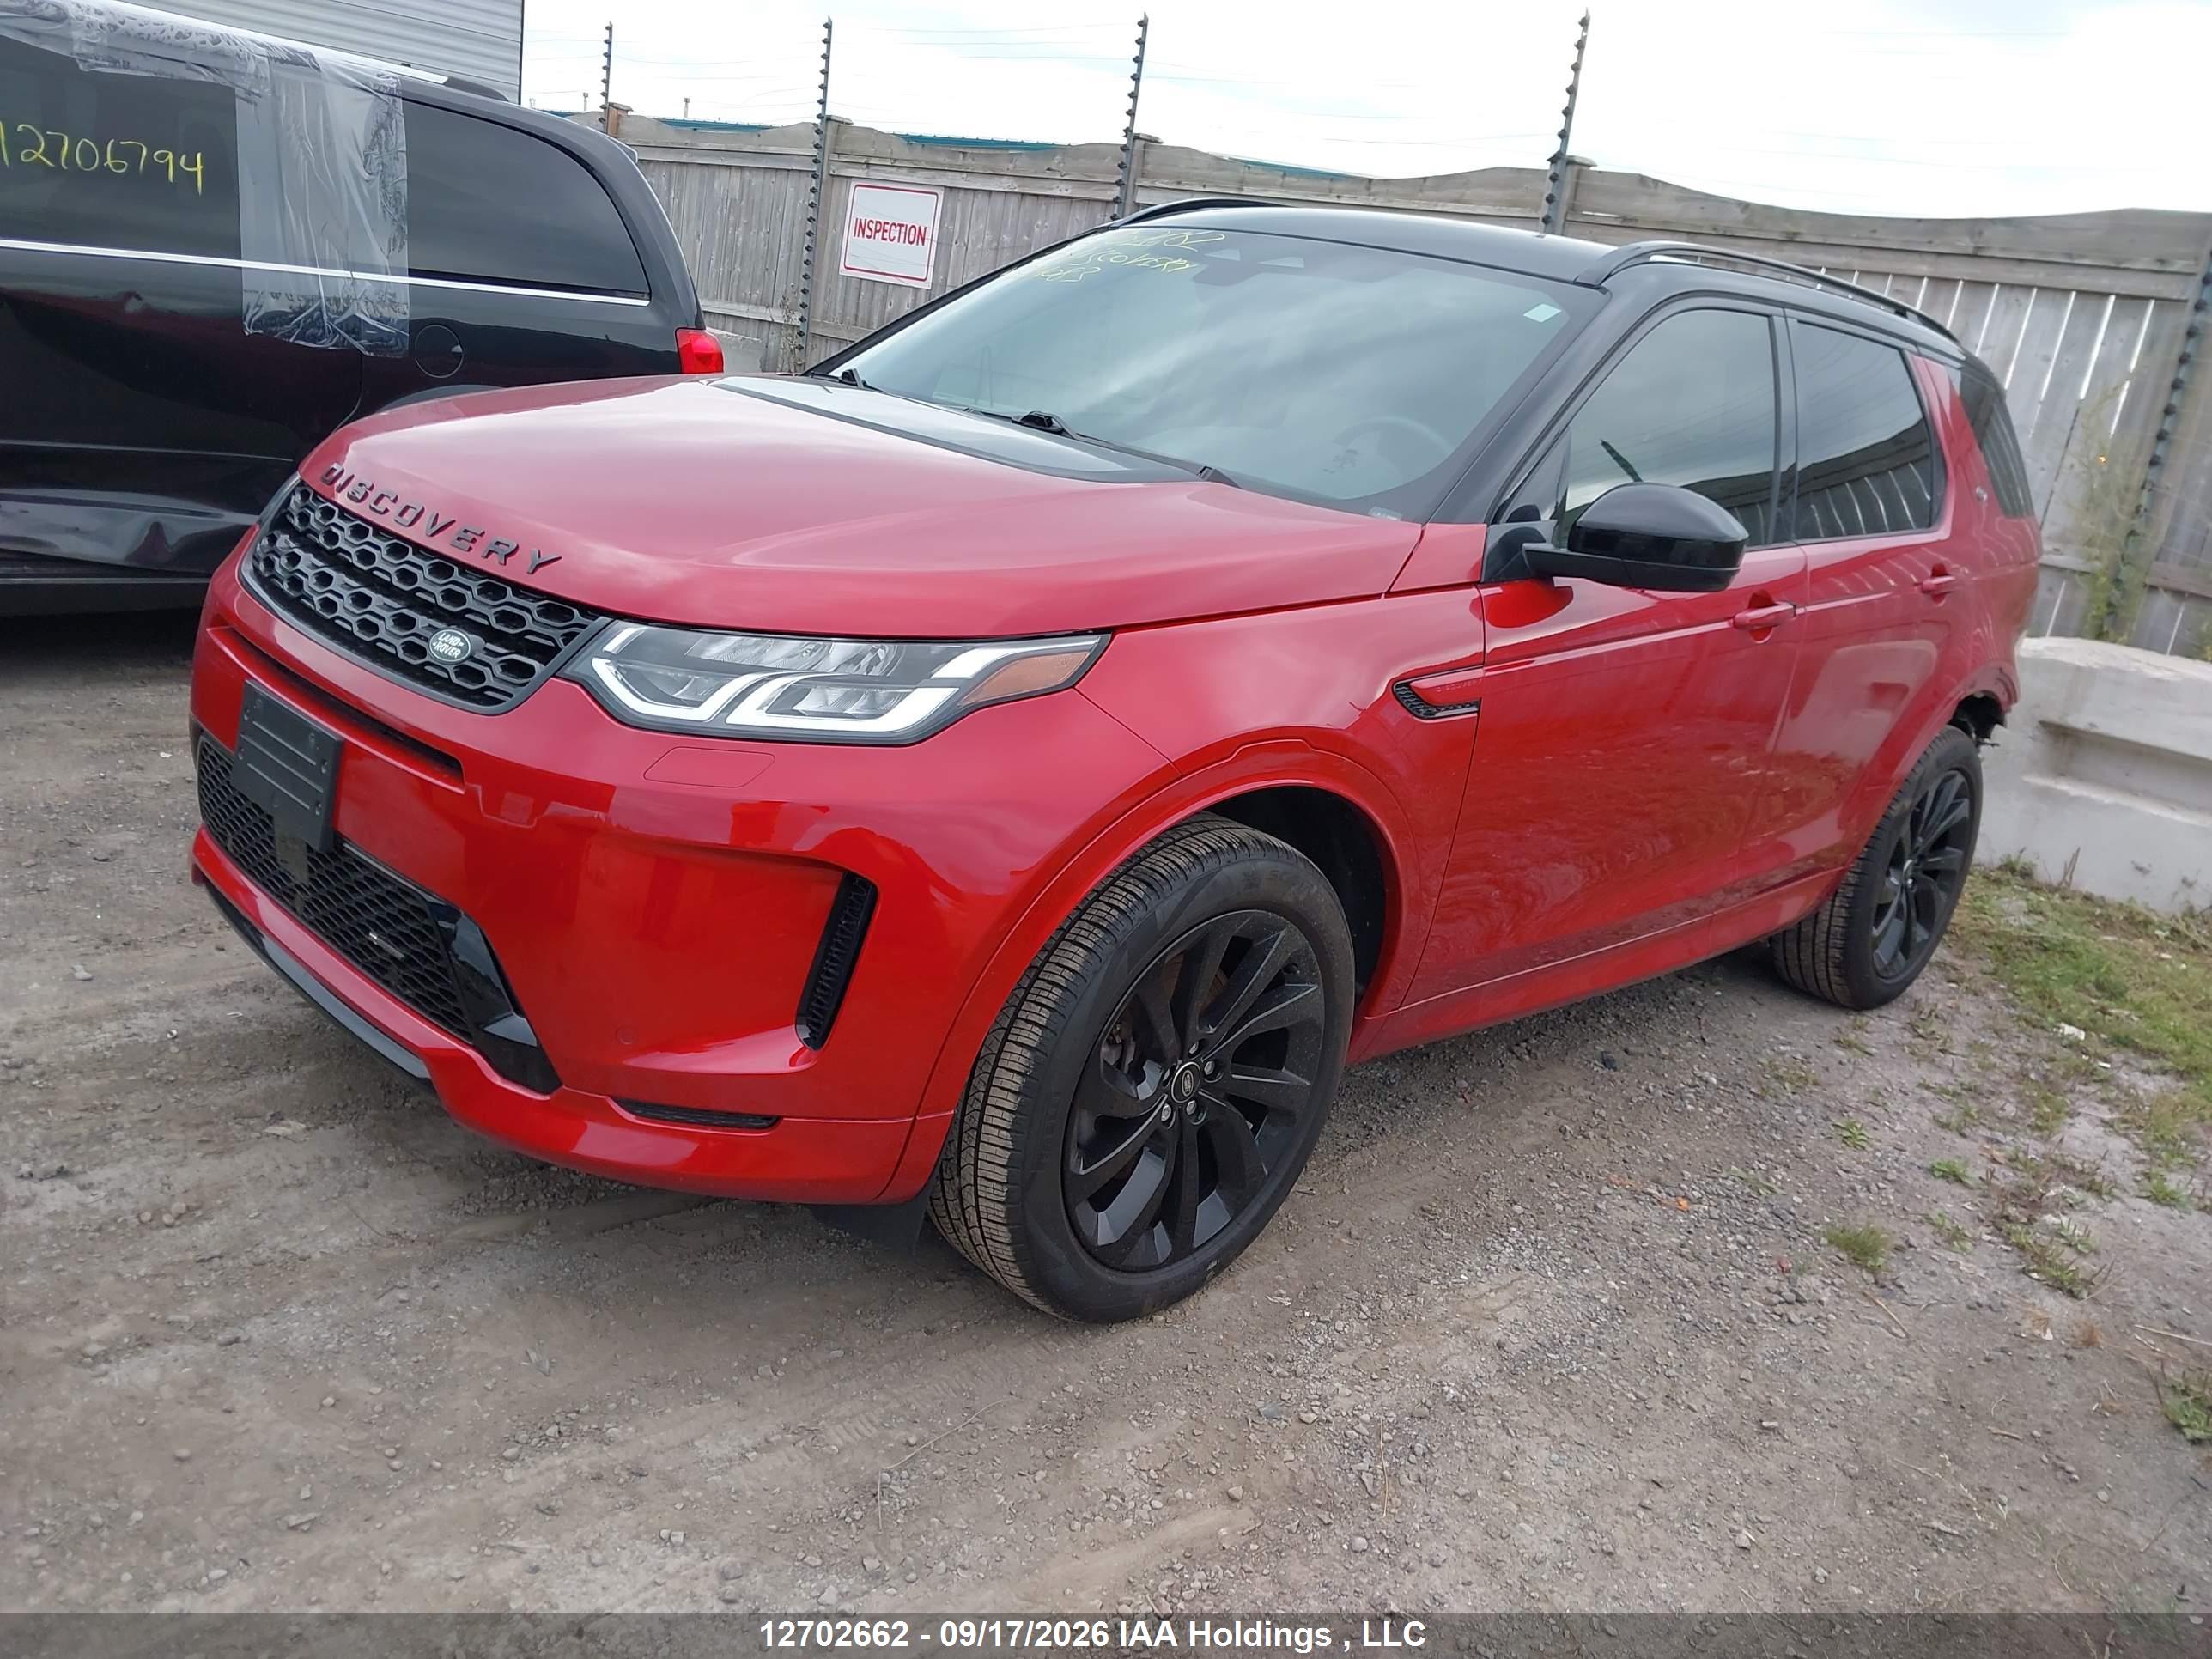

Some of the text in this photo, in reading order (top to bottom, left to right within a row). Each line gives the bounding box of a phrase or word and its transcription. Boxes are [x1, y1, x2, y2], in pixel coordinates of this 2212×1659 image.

[0, 120, 204, 197] 12706794
[853, 217, 927, 246] INSPECTION
[320, 462, 562, 574] DISCOVERY
[434, 641, 461, 659] ROVER
[438, 632, 461, 647] LAND
